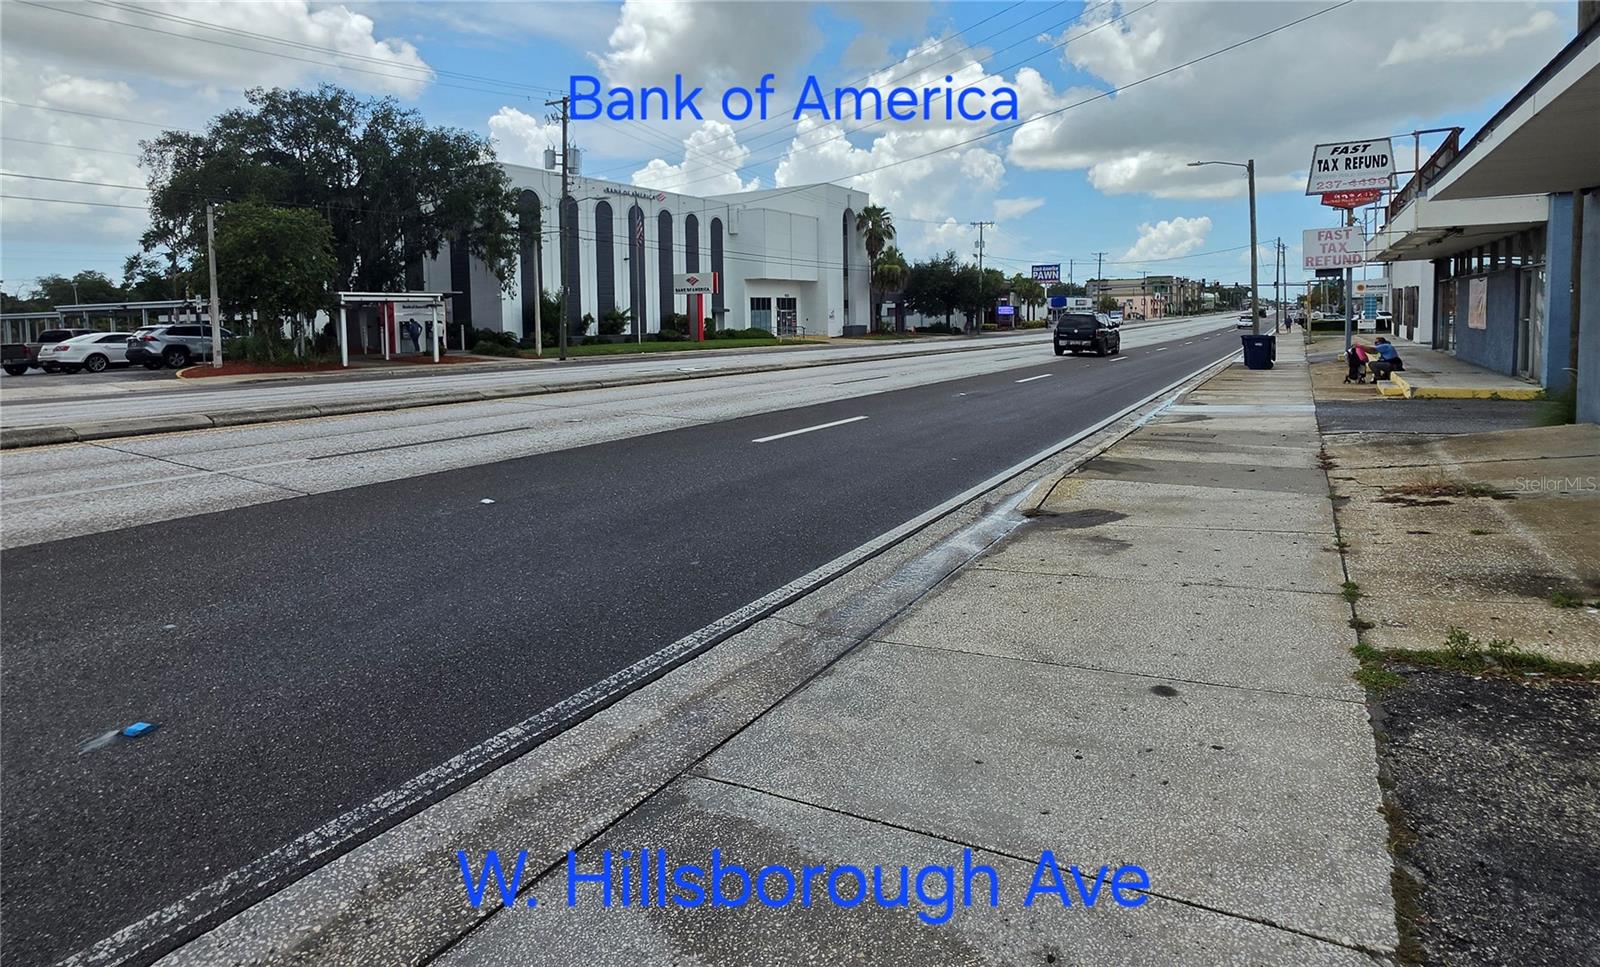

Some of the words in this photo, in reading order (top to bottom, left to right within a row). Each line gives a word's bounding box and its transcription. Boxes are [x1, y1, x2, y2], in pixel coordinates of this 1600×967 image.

[1330, 143, 1371, 155] FAST
[1317, 158, 1339, 172] TAX
[1345, 154, 1388, 170] REFUND
[1317, 229, 1352, 241] FAST
[1320, 242, 1347, 254] TAX
[1305, 254, 1362, 267] REFUND
[1032, 271, 1059, 280] PAWN
